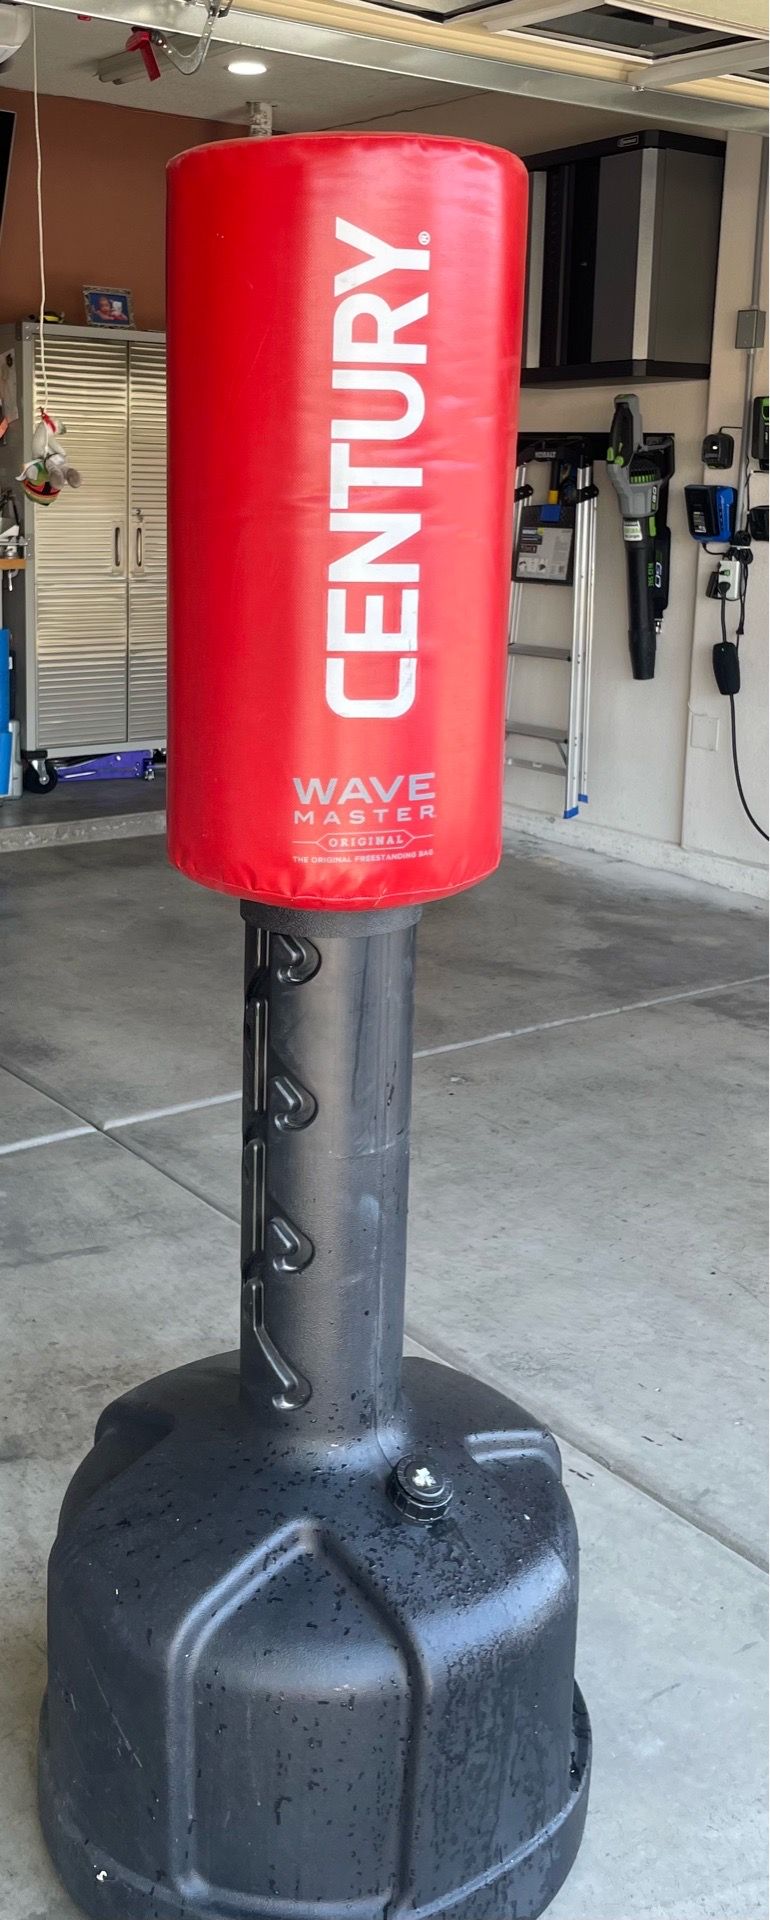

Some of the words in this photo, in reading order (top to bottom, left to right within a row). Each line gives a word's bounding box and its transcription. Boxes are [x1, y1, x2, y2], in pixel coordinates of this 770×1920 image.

[325, 216, 430, 718] CENTURY
[293, 772, 435, 805] WAVE
[294, 805, 435, 825] MASTER
[328, 836, 404, 848] ORIGINAL
[293, 855, 309, 863] THE
[311, 855, 352, 863] ORIGINAL
[354, 852, 417, 863] FREESTANDING
[418, 849, 434, 857] BAG
